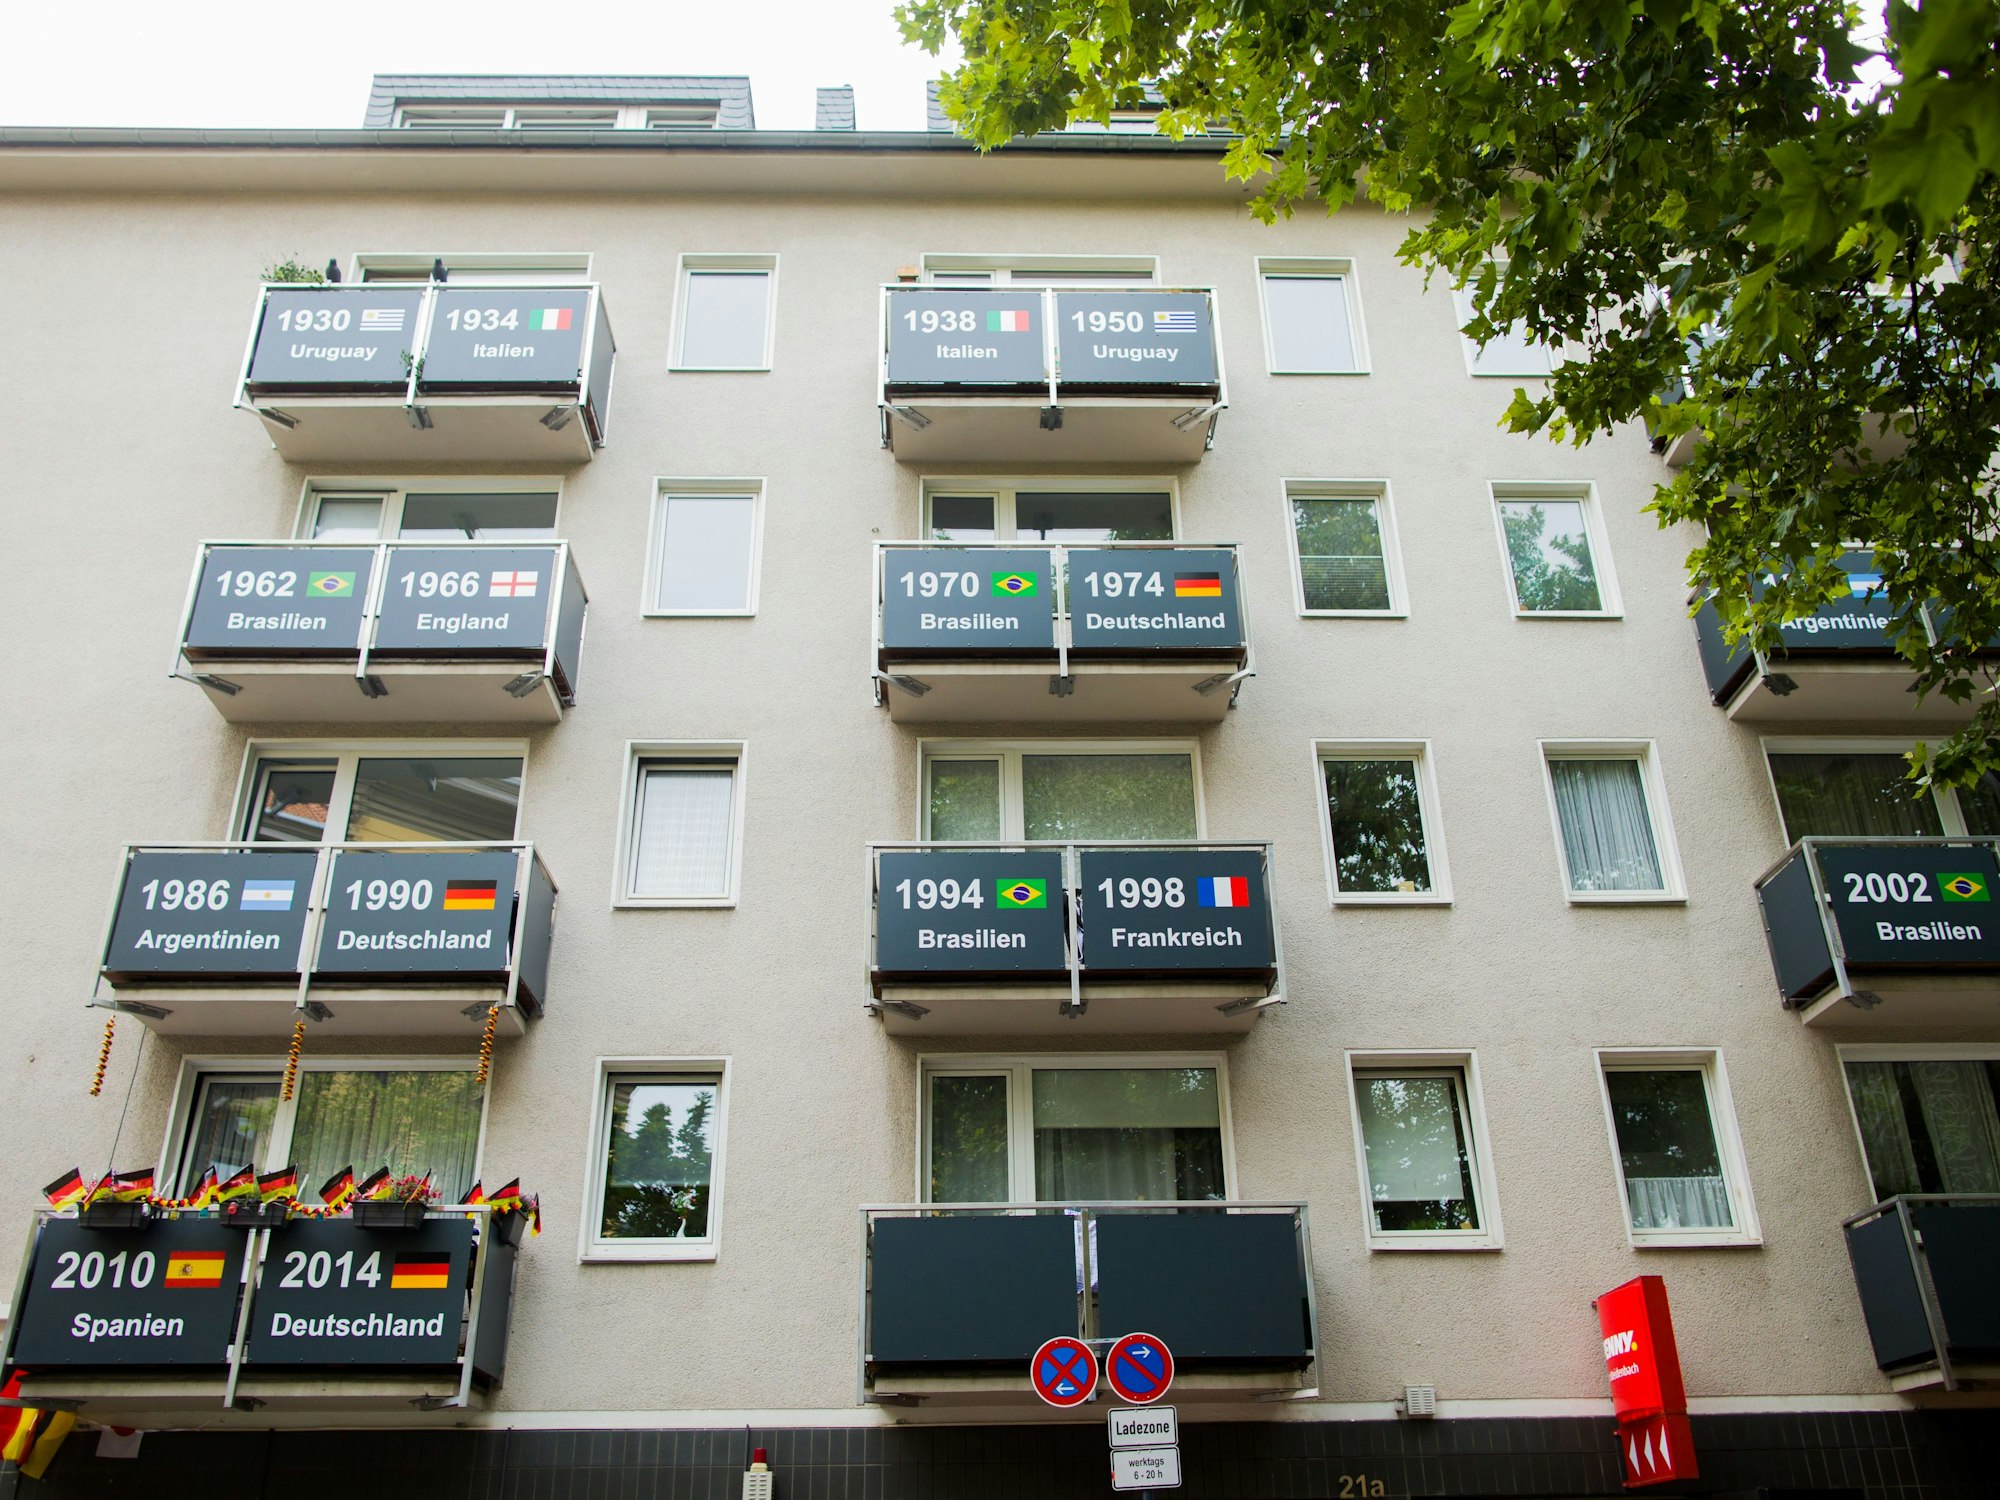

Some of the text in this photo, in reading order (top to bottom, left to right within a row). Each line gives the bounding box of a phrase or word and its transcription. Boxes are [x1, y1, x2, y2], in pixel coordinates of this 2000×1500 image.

[279, 309, 351, 332] 1930
[446, 309, 519, 331] 1934
[903, 309, 977, 333] 1938
[1071, 310, 1144, 333] 1950
[290, 343, 378, 362] Uruguay
[473, 343, 535, 358] Italien
[936, 343, 998, 359] Italien
[1093, 344, 1179, 362] Uruguay
[217, 570, 297, 597] 1962
[400, 571, 480, 598] 1966
[900, 571, 980, 598] 1970
[1084, 571, 1165, 598] 1974
[227, 612, 327, 630] Brasilien
[417, 612, 510, 634] England
[920, 612, 1019, 630] Brasilien
[1086, 612, 1226, 630] Deutschland
[1780, 613, 1899, 634] Argentinie
[142, 879, 231, 911] 1986
[345, 879, 433, 911] 1990
[895, 878, 985, 910] 1994
[1098, 877, 1186, 909] 1998
[1843, 872, 1933, 903] 2002
[135, 929, 281, 954] Argentinien
[337, 929, 492, 950] Deutschland
[918, 928, 1026, 949] Brasilien
[1111, 926, 1243, 948] Frankreich
[1876, 921, 1982, 941] Brasilien
[51, 1250, 156, 1289] 2010
[280, 1250, 382, 1289] 2014
[72, 1312, 184, 1343] Spanien
[271, 1312, 444, 1337] Deutschland
[1116, 1420, 1170, 1435] Ladezone
[1129, 1458, 1165, 1468] werktags
[1134, 1471, 1139, 1480] 6
[1146, 1470, 1155, 1479] 20
[1158, 1469, 1163, 1478] h
[1338, 1474, 1385, 1499] 21a
